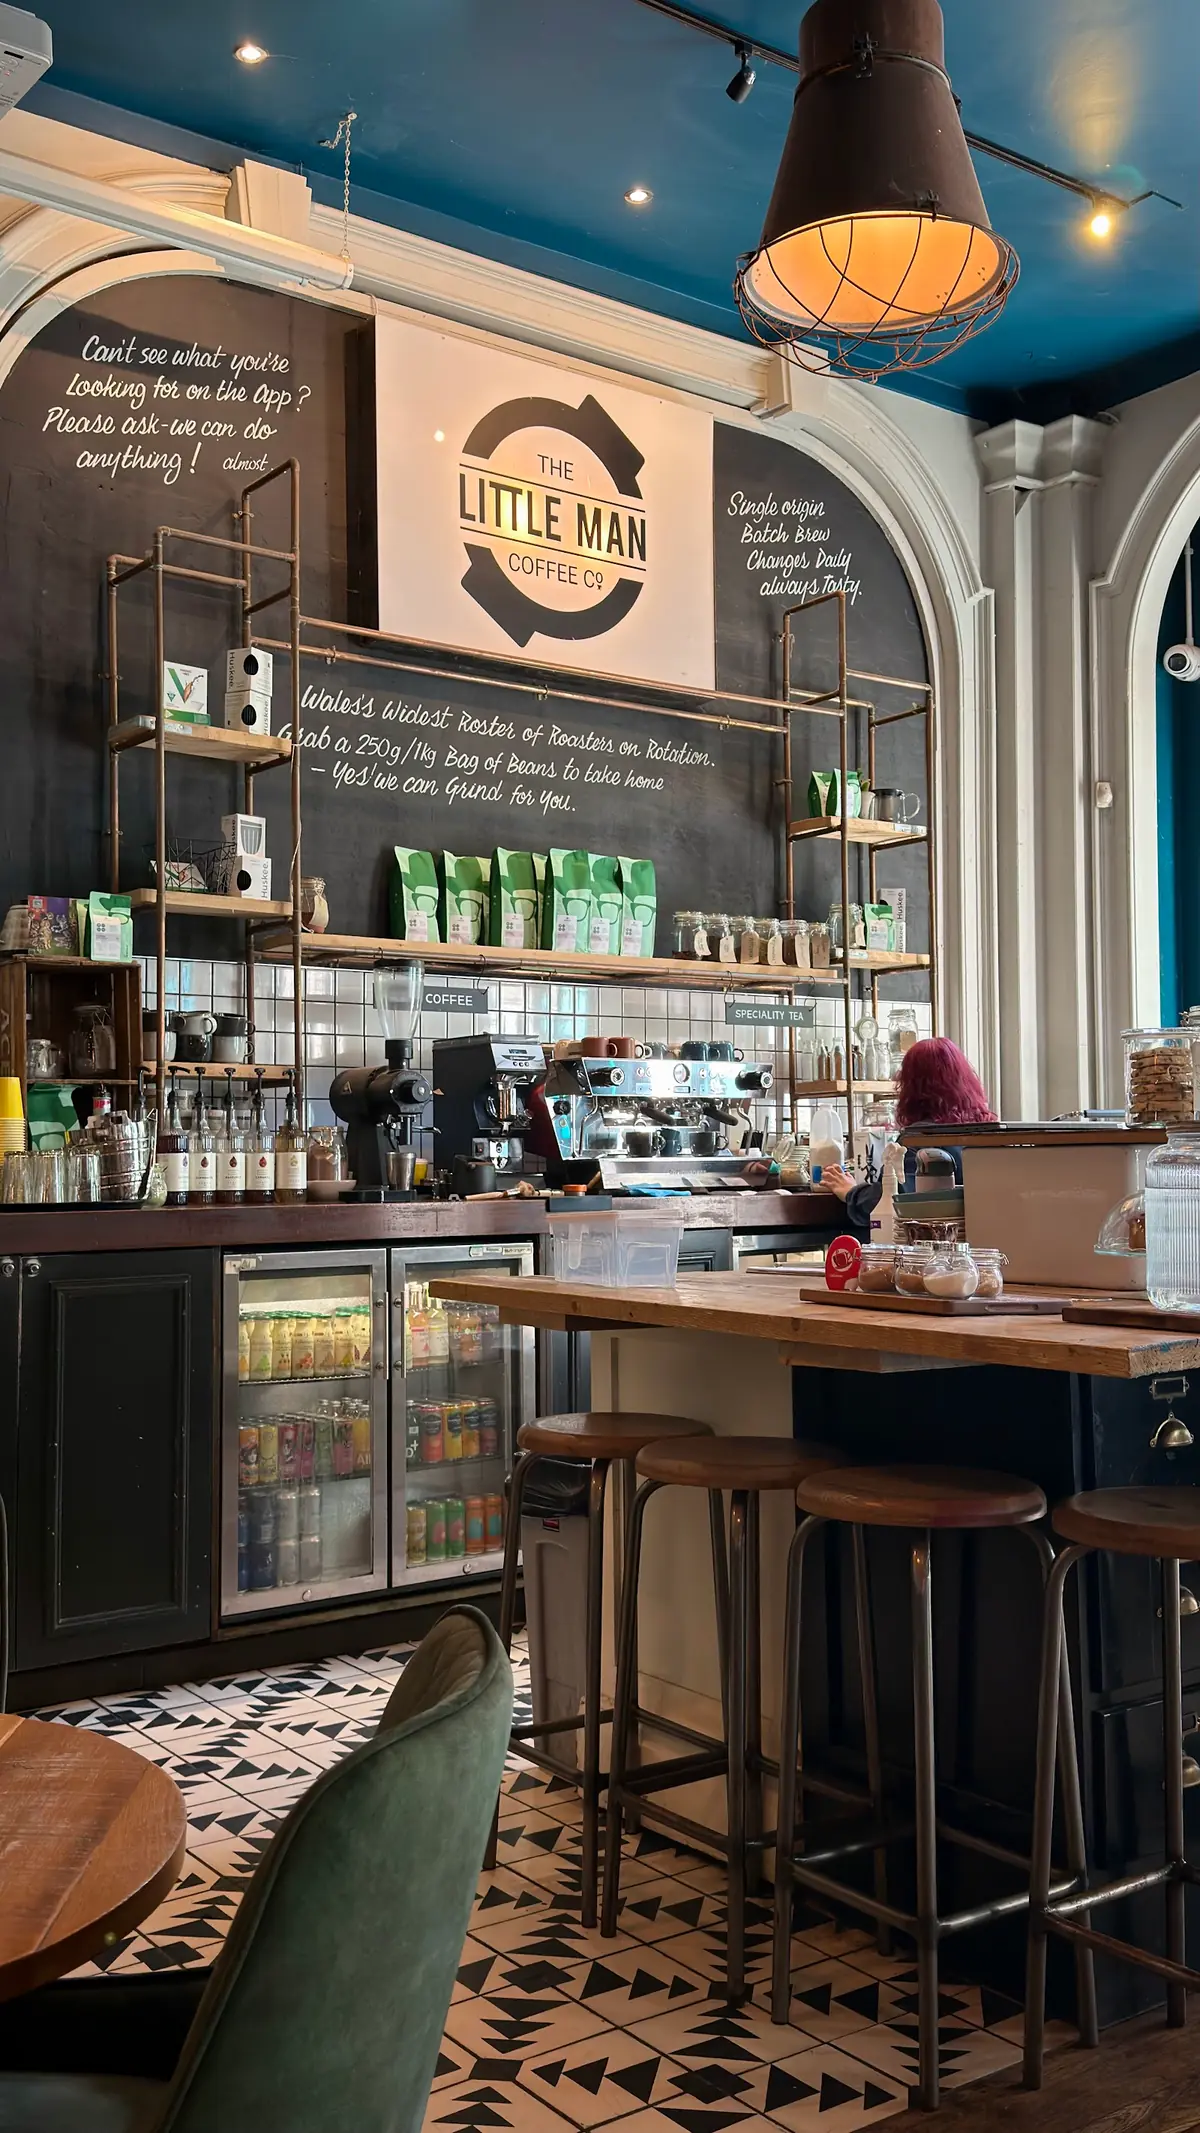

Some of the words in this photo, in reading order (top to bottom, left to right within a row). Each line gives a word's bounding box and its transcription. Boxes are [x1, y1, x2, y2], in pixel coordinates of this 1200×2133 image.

[81, 334, 137, 363] Can't
[139, 346, 168, 366] see
[172, 342, 226, 369] what
[230, 351, 290, 380] you're
[65, 373, 146, 410] Looking
[152, 376, 180, 400] for
[186, 383, 211, 401] on
[216, 380, 248, 402] the
[41, 406, 115, 435] Please
[201, 419, 237, 440] can
[243, 417, 278, 441] do
[537, 453, 574, 481] THE
[459, 472, 562, 543] LITTLE
[577, 502, 647, 562] MAN
[727, 490, 778, 523] Single
[781, 498, 825, 523] origin
[741, 522, 789, 544] Batch
[794, 524, 831, 544] Brew
[508, 552, 579, 586] COFFEE
[746, 549, 810, 578] Changes
[815, 547, 852, 575] Daily
[759, 575, 820, 605] always
[300, 684, 376, 719] Wales's
[381, 700, 454, 729] Widest
[457, 711, 516, 740] Roster
[522, 724, 544, 747] of
[548, 724, 615, 754] Roasters
[619, 740, 642, 758] on
[645, 738, 716, 767] Rotation.
[334, 736, 352, 754] a
[444, 744, 479, 775] Bag
[484, 751, 504, 774] of
[506, 752, 557, 778] Beans
[562, 757, 580, 782] to
[584, 763, 621, 786] take
[624, 769, 665, 791] home
[402, 775, 439, 796] can
[445, 775, 504, 805] Grind
[509, 784, 535, 806] for
[425, 993, 473, 1006] COFFEE
[735, 1009, 785, 1020] SPECIALITY
[788, 1011, 804, 1021] TEA
